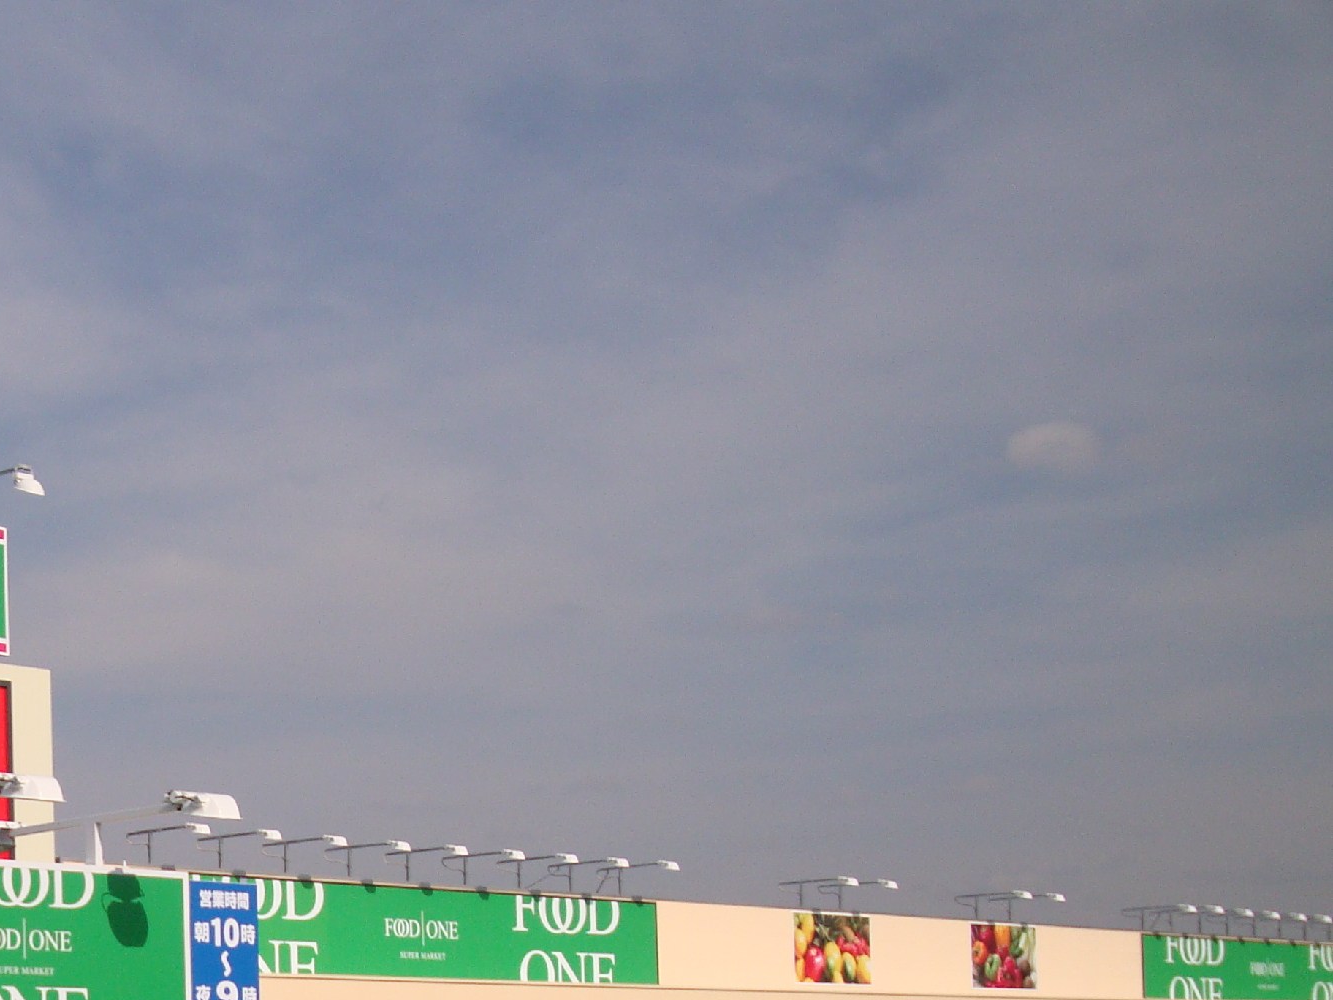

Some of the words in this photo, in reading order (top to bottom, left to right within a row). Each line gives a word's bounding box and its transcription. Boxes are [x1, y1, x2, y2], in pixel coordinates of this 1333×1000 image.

[199, 889, 249, 910] 営業時間
[512, 895, 621, 935] FOOD
[28, 930, 73, 953] ONE
[193, 917, 256, 948] 朝10時
[384, 918, 420, 938] FOOD
[425, 919, 459, 940] ONE
[1164, 936, 1225, 965] FOOD
[20, 967, 55, 976] MARKET
[519, 950, 616, 983] ONE
[1169, 975, 1224, 1000] ONE
